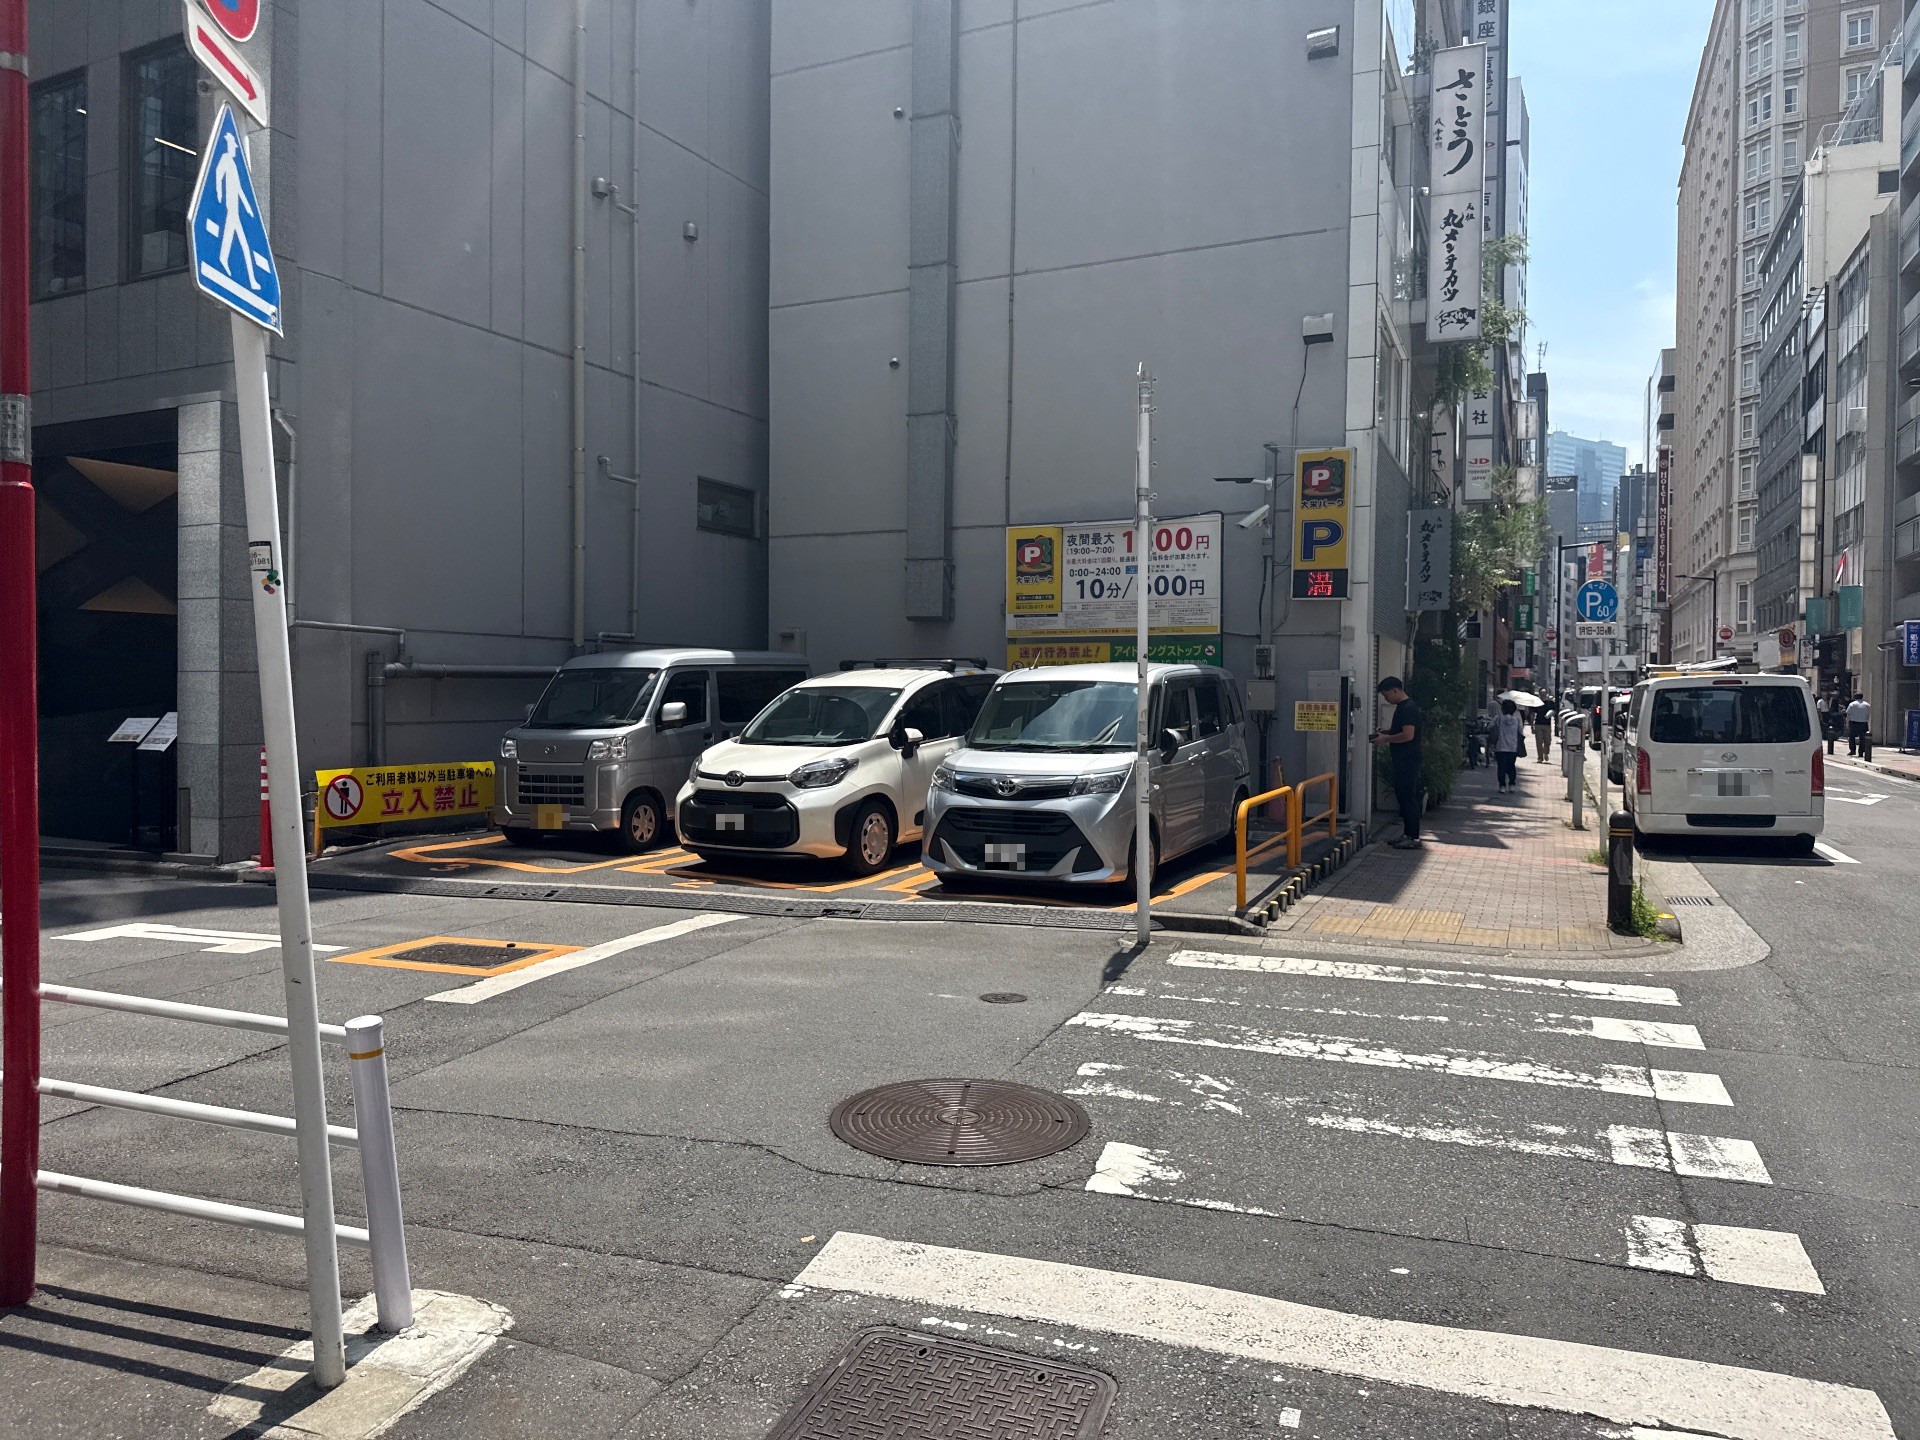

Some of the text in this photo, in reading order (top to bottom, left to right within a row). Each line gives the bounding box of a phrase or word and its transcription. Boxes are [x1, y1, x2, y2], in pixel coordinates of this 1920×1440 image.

[1436, 69, 1476, 176] さとう
[1440, 208, 1464, 302] 丸メンチカツ
[1300, 499, 1345, 509] 大栄パーク
[1067, 527, 1210, 553] 夜間最大 100円
[1301, 519, 1344, 562] P
[1308, 571, 1334, 596] 満
[1586, 592, 1602, 617] P
[1597, 605, 1610, 617] 60
[1115, 644, 1202, 657] アイドングストップ
[366, 767, 493, 786] ご利用者様以外当駐車場への
[381, 784, 480, 816] 立入禁止
